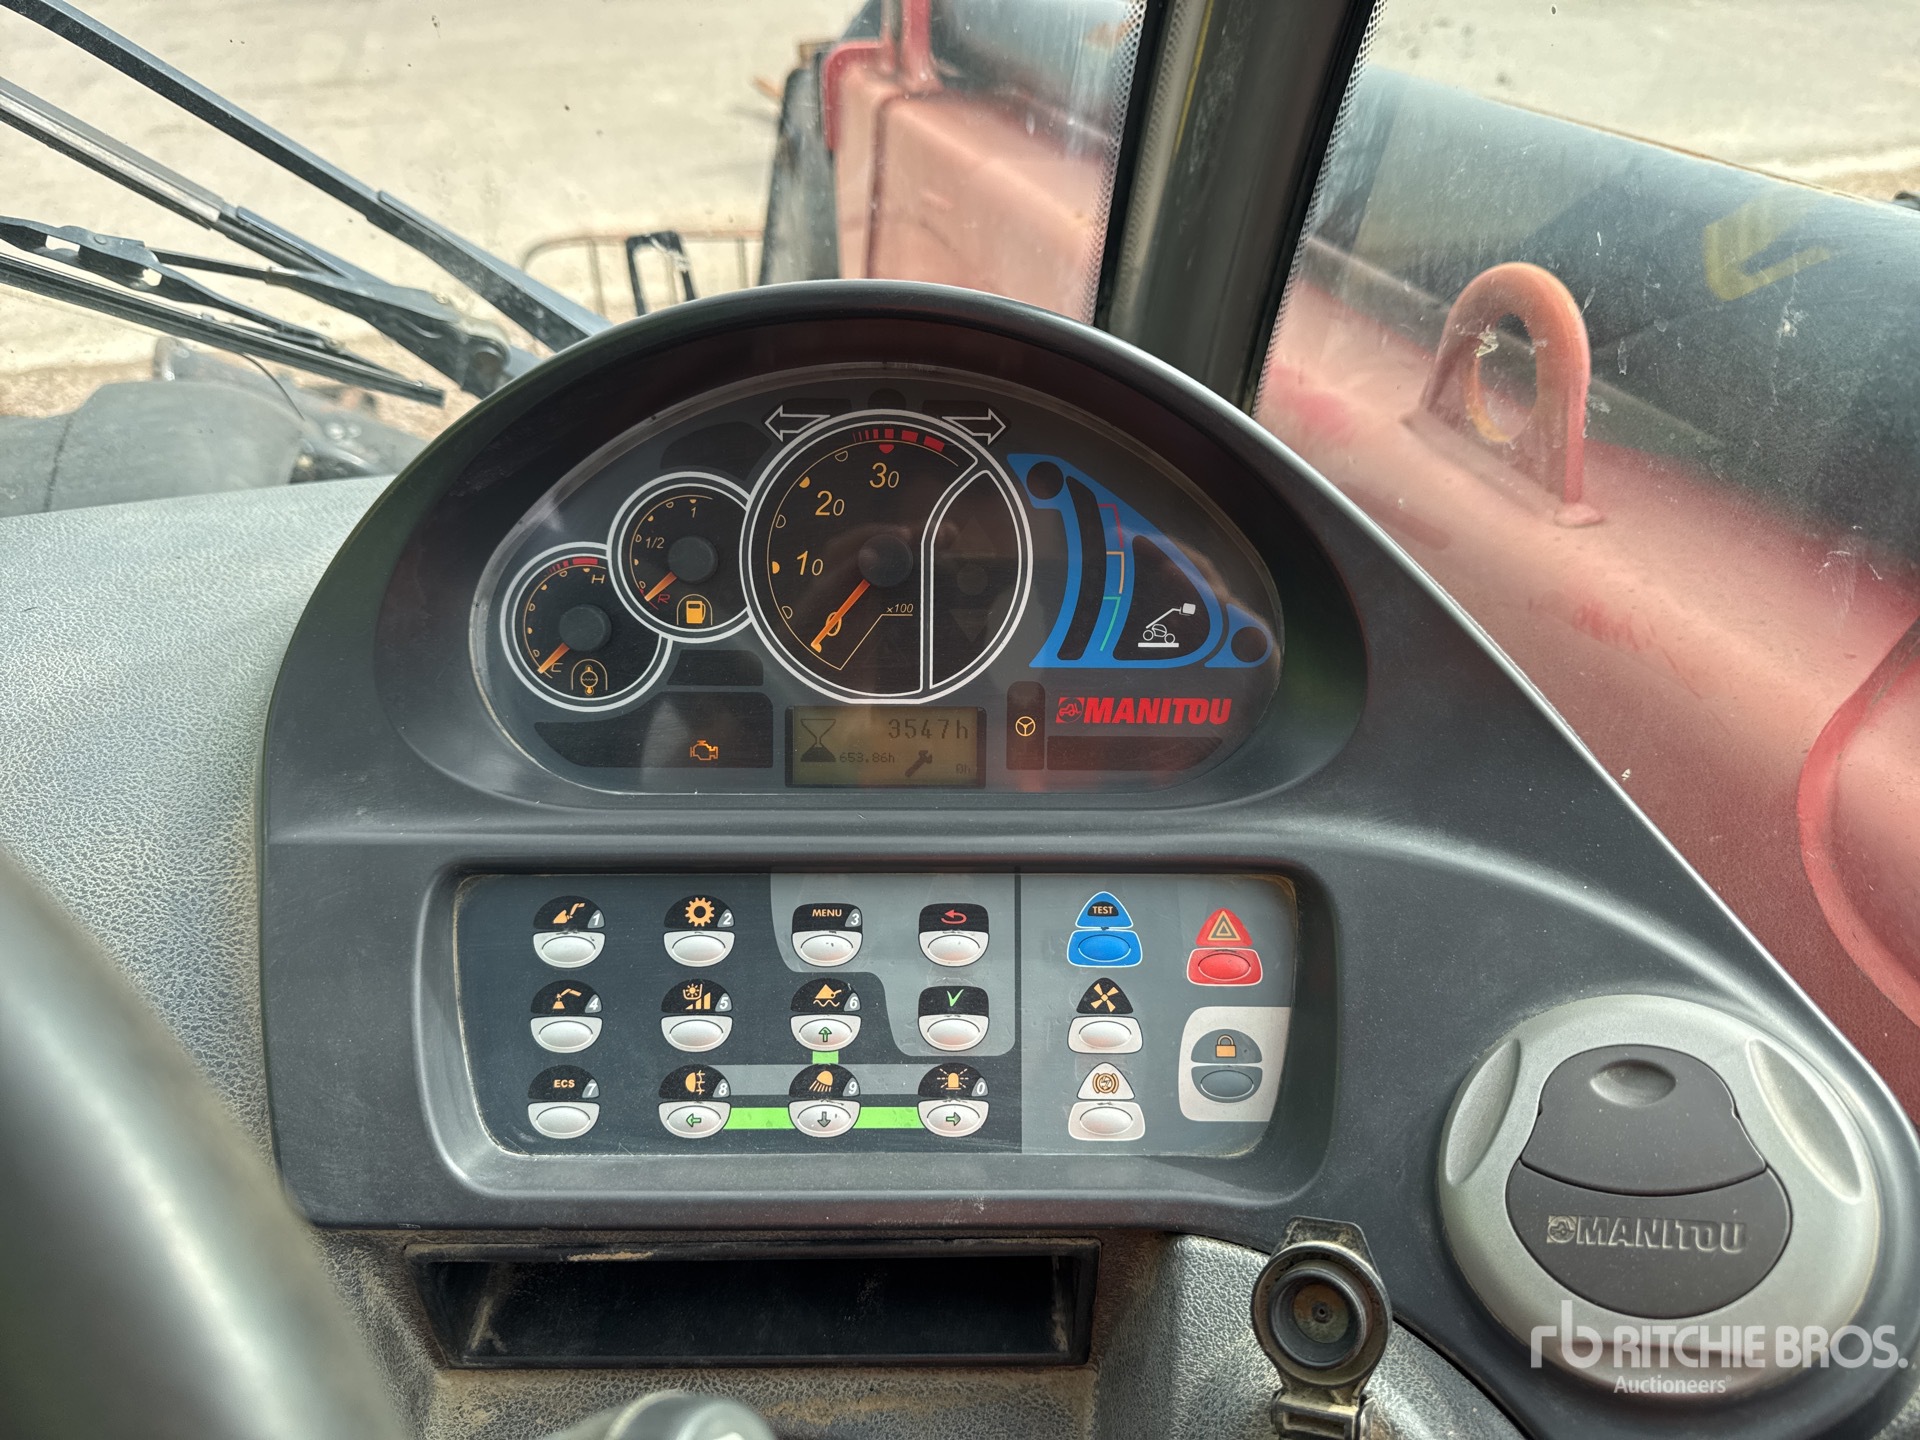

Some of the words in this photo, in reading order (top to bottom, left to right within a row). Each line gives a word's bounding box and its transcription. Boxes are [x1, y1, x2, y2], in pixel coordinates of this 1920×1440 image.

[869, 463, 900, 489] 30
[815, 491, 845, 517] 20
[690, 508, 697, 517] 1
[646, 537, 664, 549] 1/2
[796, 551, 824, 576] 10
[1084, 697, 1232, 725] MANITOU
[888, 719, 968, 739] 3547h
[839, 752, 895, 763] 653.86h
[812, 908, 842, 918] MENU
[1092, 905, 1113, 914] TEST
[593, 914, 600, 926] 1
[723, 913, 732, 926] 2
[850, 913, 860, 926] 3
[589, 998, 599, 1010] 4
[719, 997, 728, 1010] 5
[848, 997, 858, 1010] 6
[554, 1079, 575, 1088] ECS
[587, 1083, 596, 1096] 7
[718, 1083, 727, 1096] 8
[848, 1082, 857, 1095] 9
[976, 1081, 985, 1095] 0
[1576, 1217, 1746, 1253] MANITOU
